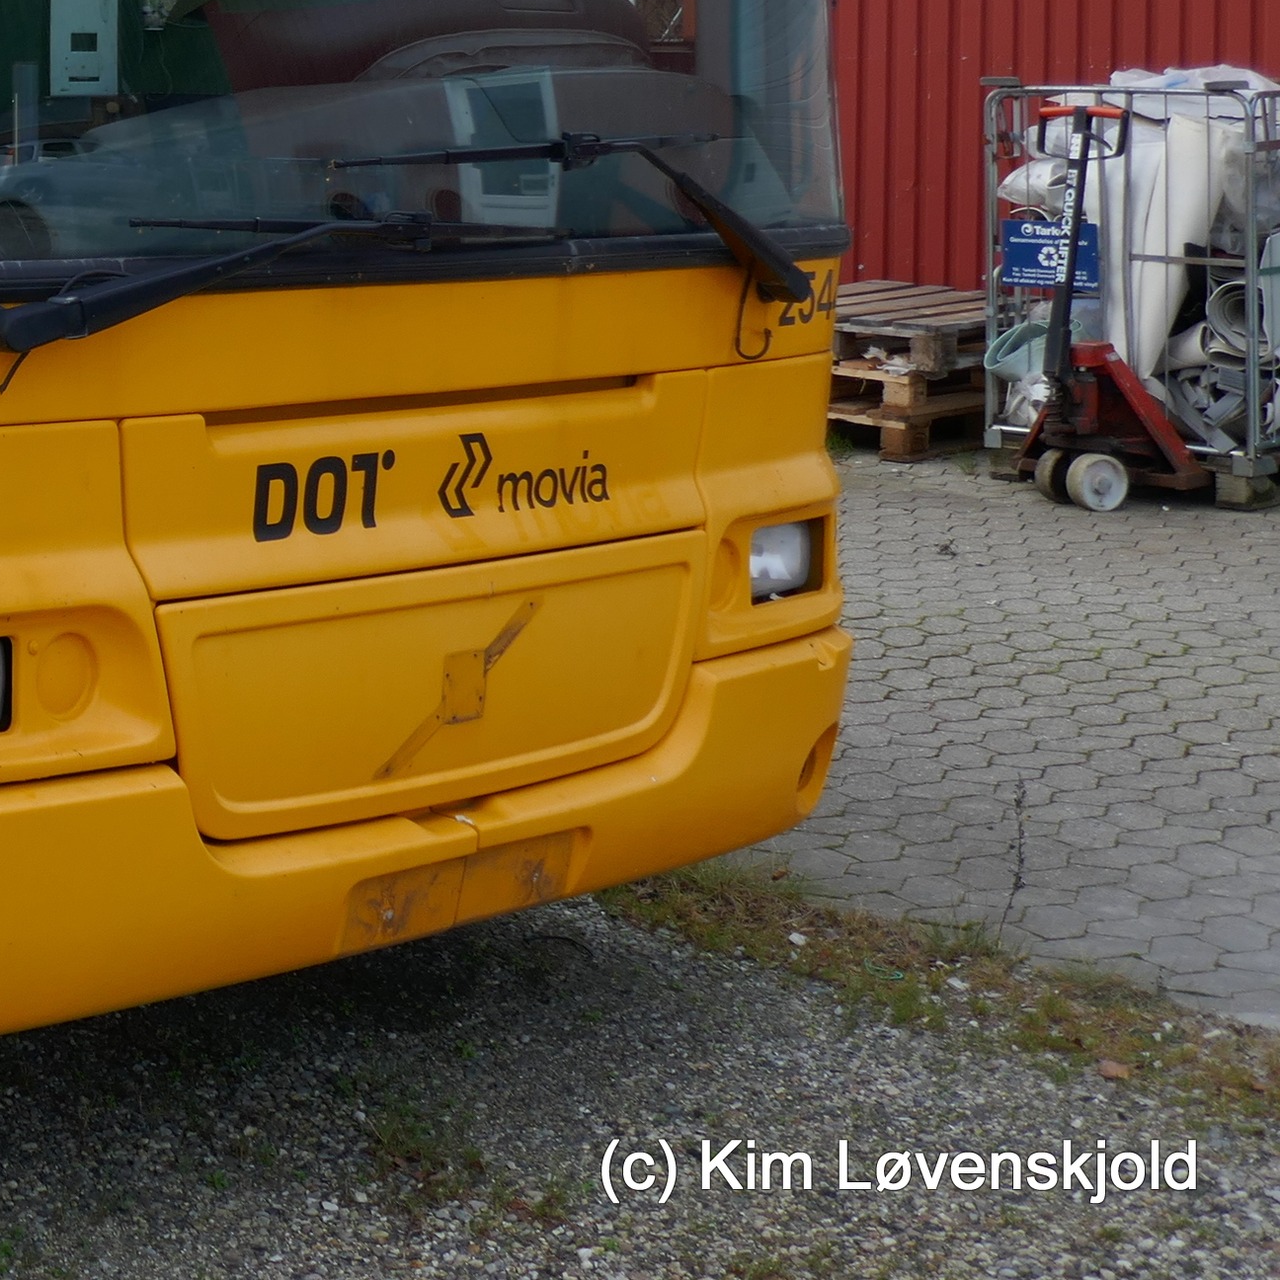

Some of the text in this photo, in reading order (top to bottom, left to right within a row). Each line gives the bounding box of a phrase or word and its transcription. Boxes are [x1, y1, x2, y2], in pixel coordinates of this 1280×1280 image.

[1060, 189, 1076, 237] QUICK
[1055, 239, 1070, 283] LIFTER
[497, 450, 611, 513] movia
